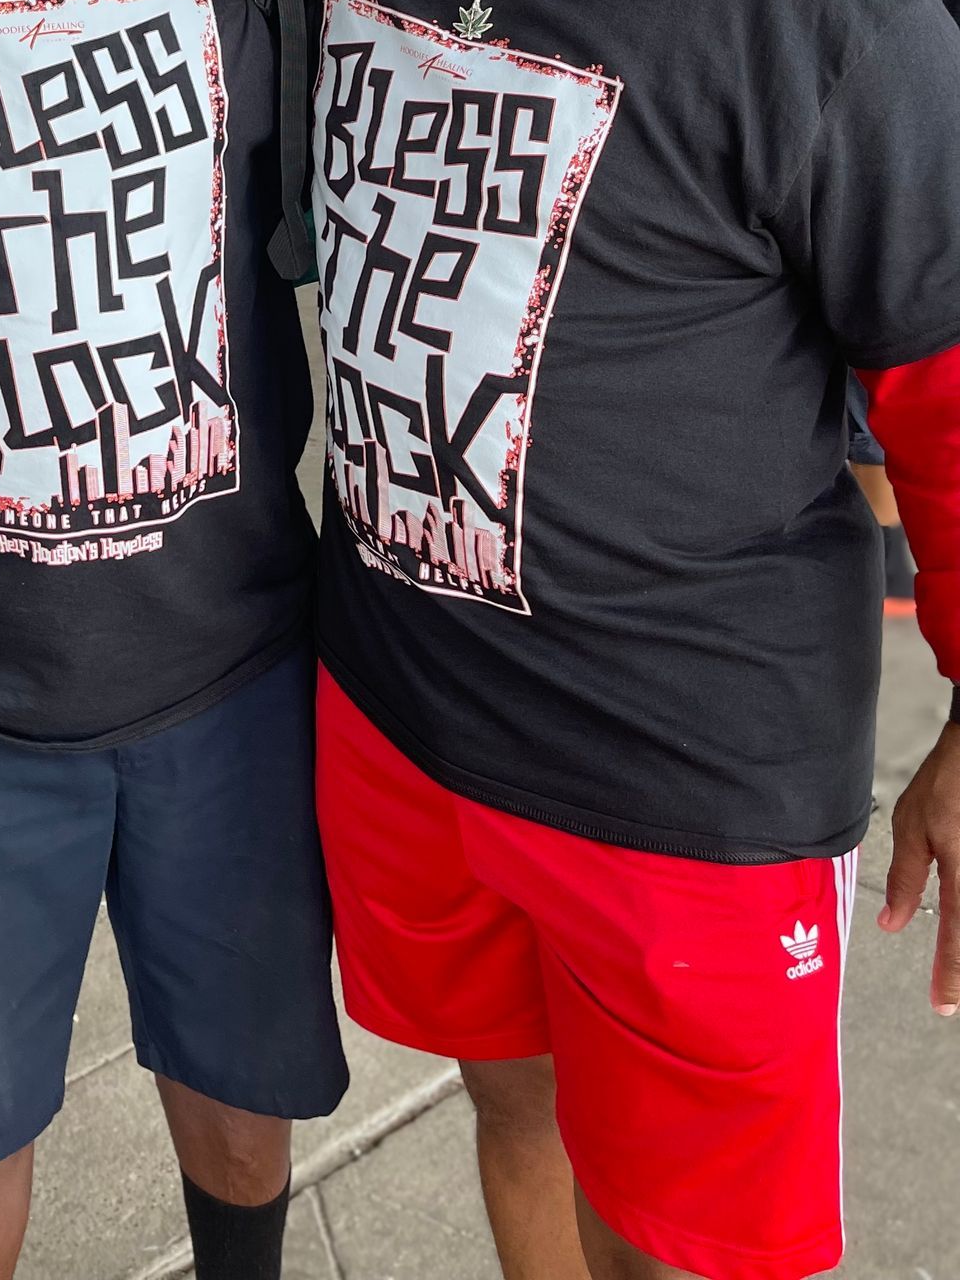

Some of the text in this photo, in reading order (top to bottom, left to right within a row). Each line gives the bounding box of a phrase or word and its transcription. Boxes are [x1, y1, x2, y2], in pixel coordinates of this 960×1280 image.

[43, 20, 85, 31] HEALING
[400, 45, 429, 61] HOODIES
[436, 59, 473, 77] HEALING
[91, 504, 142, 526] THAT
[161, 480, 207, 515] HELPS
[418, 562, 484, 596] HELPS
[786, 954, 824, 980] adidas
